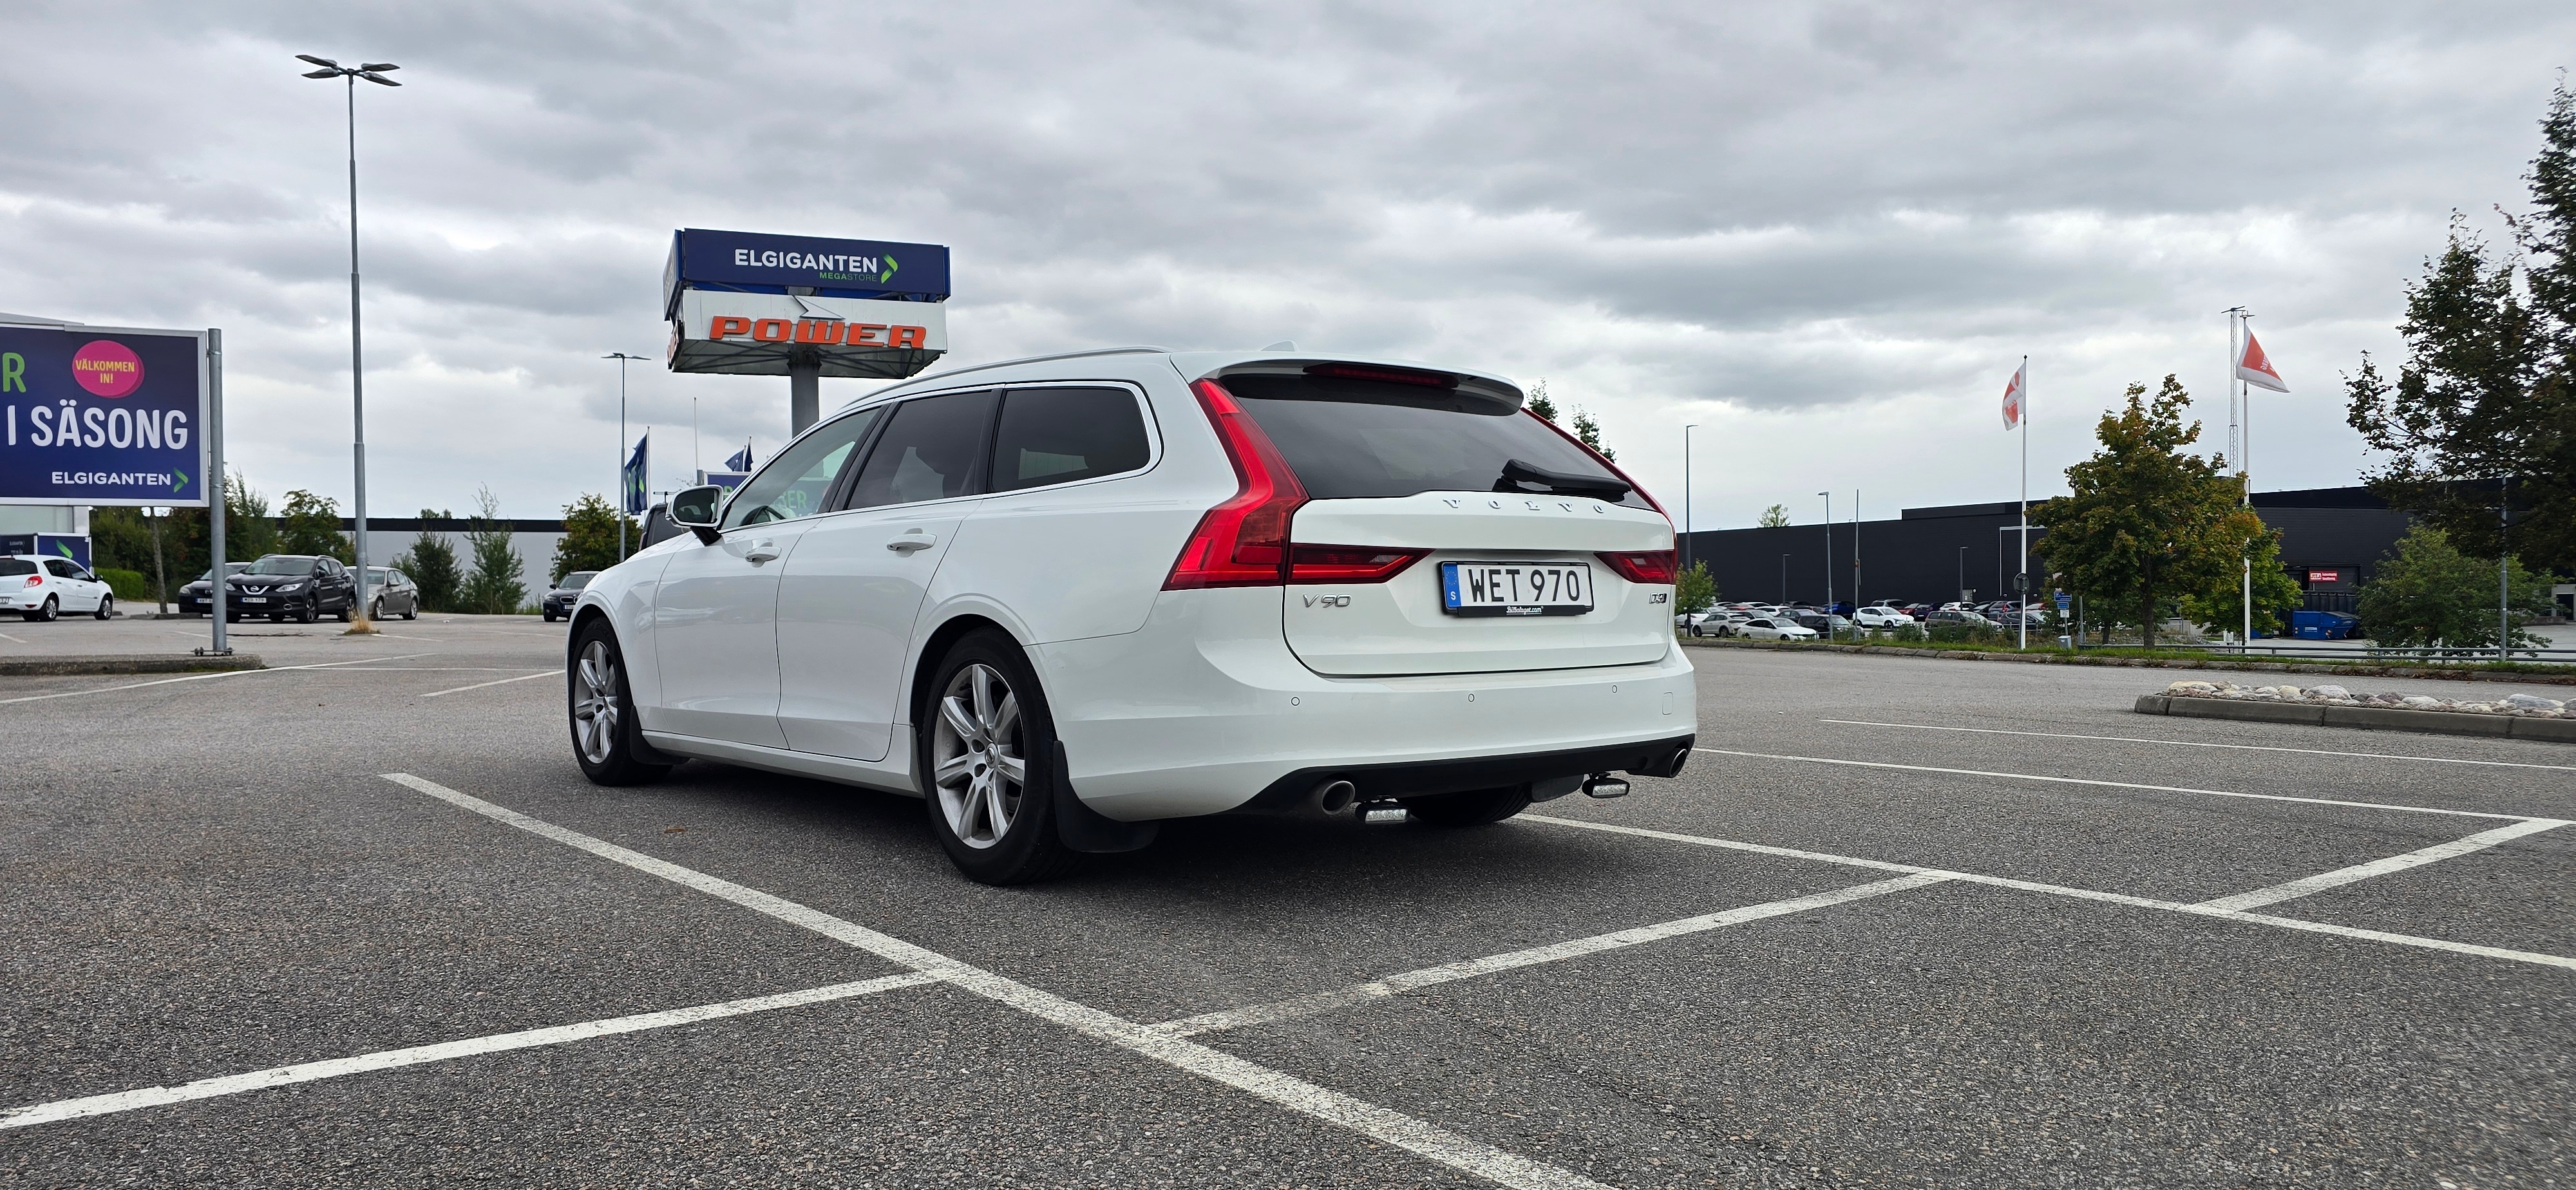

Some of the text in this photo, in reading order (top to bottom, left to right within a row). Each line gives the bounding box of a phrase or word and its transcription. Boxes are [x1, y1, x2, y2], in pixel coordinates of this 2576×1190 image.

[735, 249, 877, 273] ELGIGANTEN
[819, 272, 877, 281] MEGASTORE
[709, 316, 926, 348] POWER
[3, 352, 26, 392] R
[76, 359, 135, 372] VÄLKOMMEN
[100, 373, 113, 384] IN!
[8, 399, 188, 449] I SÄSONG
[52, 472, 171, 486] ELGIGANTEN
[1443, 498, 1604, 514] VOLVO
[1468, 569, 1580, 602] WET 970
[1450, 590, 1457, 601] S
